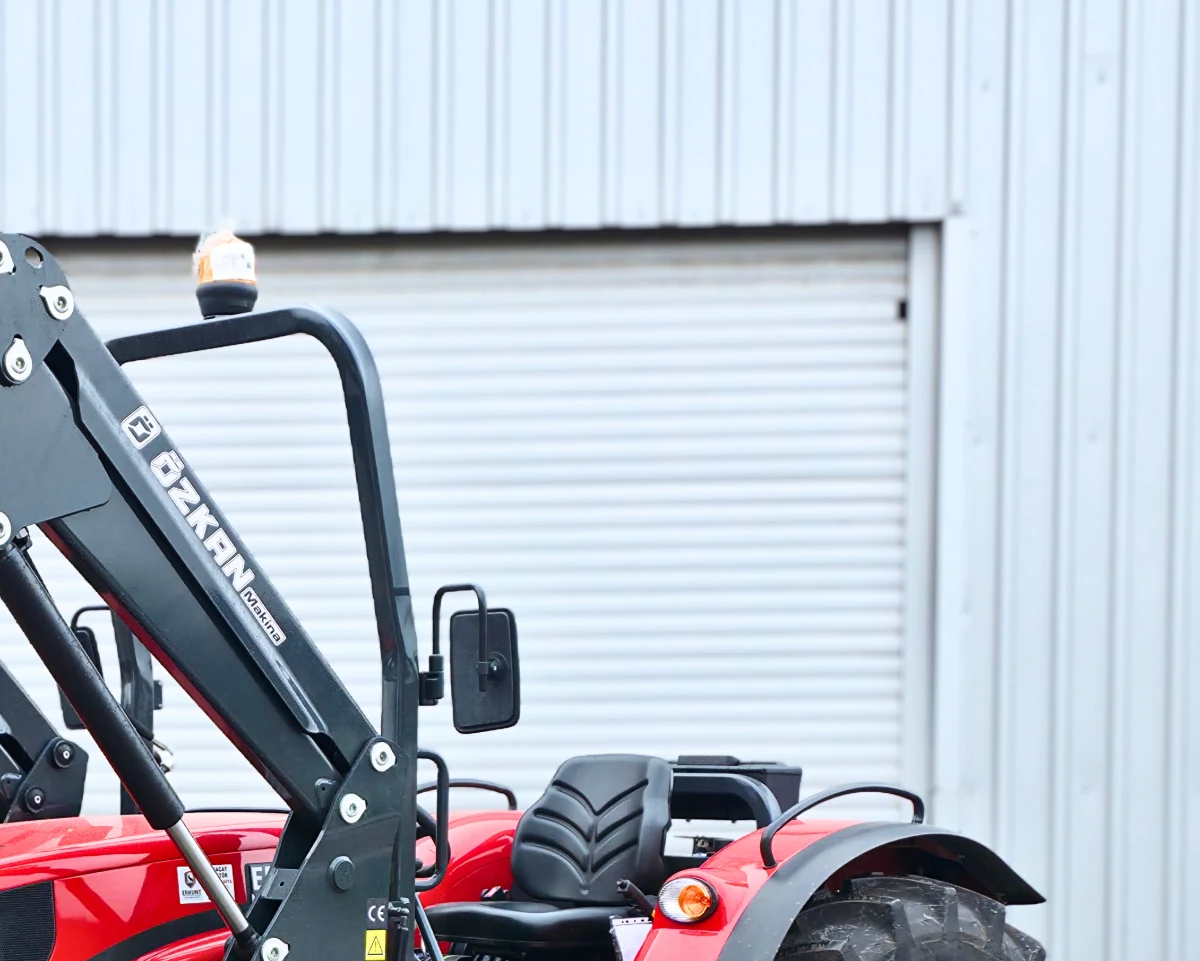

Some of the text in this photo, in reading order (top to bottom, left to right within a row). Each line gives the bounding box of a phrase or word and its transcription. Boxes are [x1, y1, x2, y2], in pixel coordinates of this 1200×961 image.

[150, 450, 255, 592] ÖZKAN
[244, 590, 281, 642] Makina
[368, 904, 385, 922] CE
